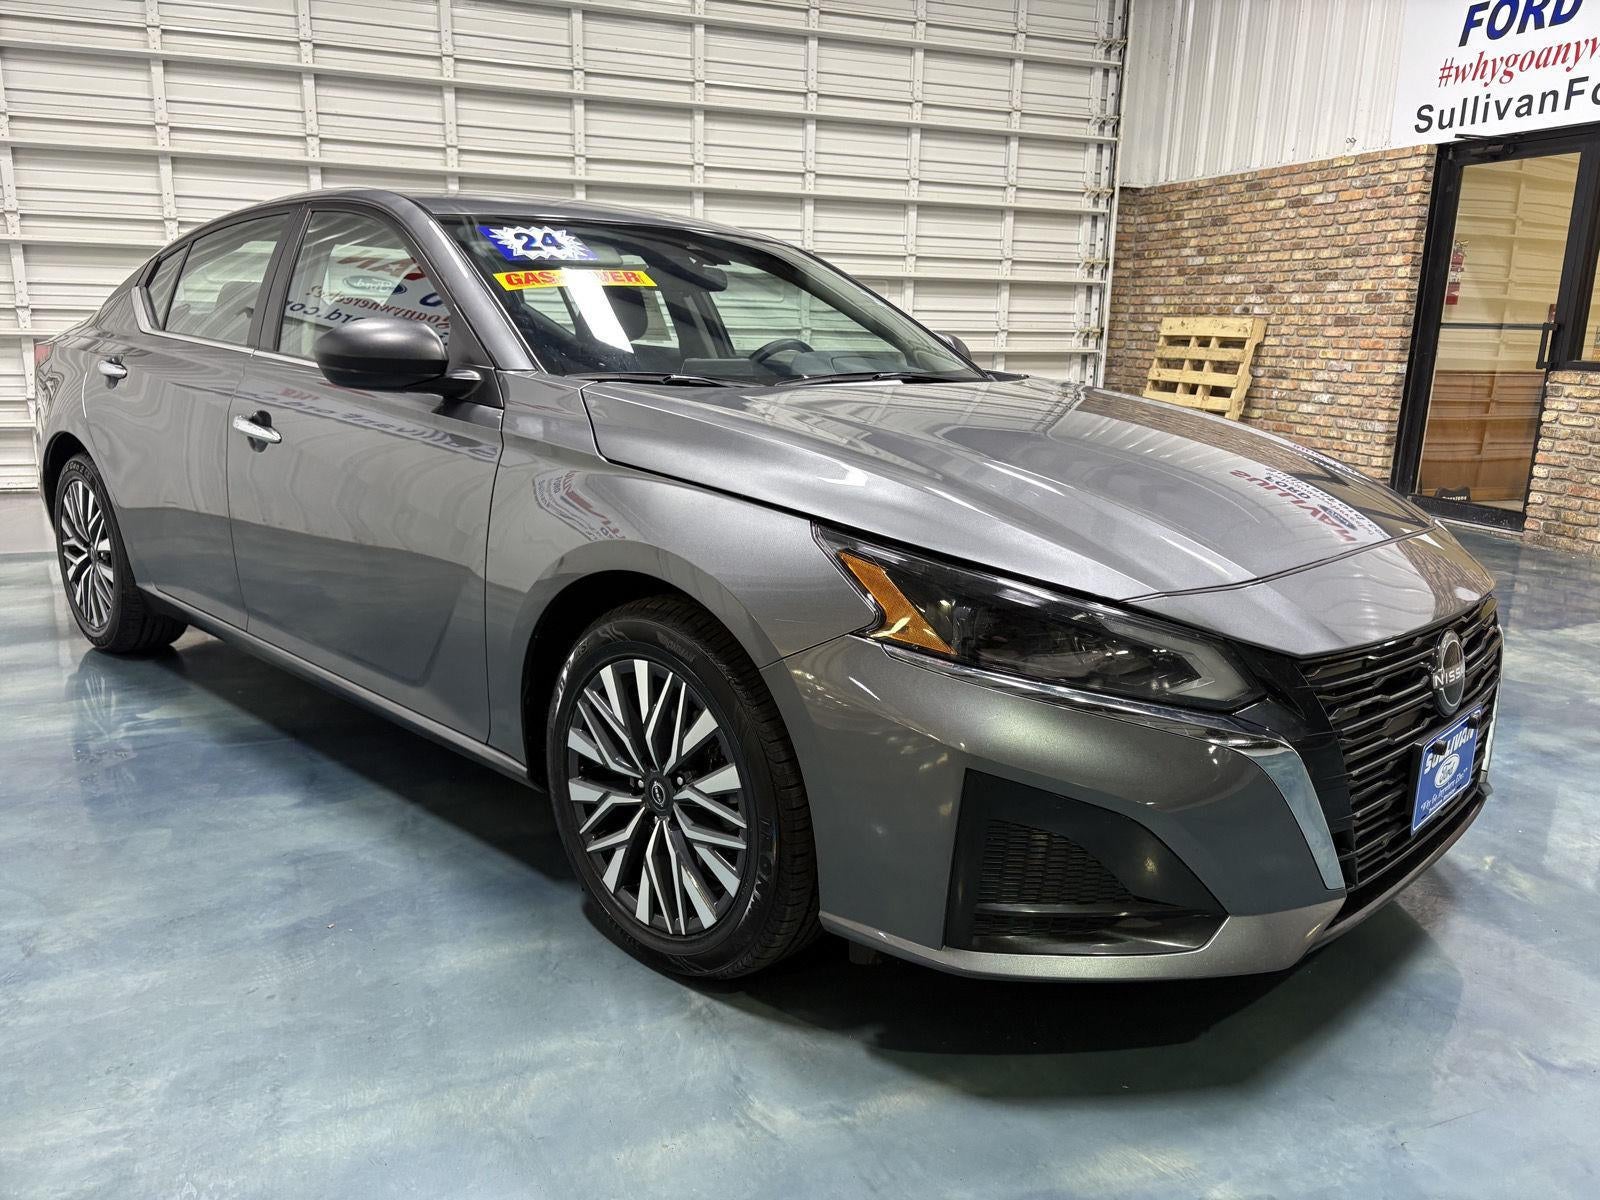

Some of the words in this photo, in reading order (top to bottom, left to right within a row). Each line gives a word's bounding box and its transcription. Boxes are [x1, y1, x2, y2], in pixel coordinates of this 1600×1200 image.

[1458, 0, 1583, 47] FORD
[513, 232, 567, 251] 24
[504, 271, 555, 286] GAS
[1434, 666, 1464, 687] NISS
